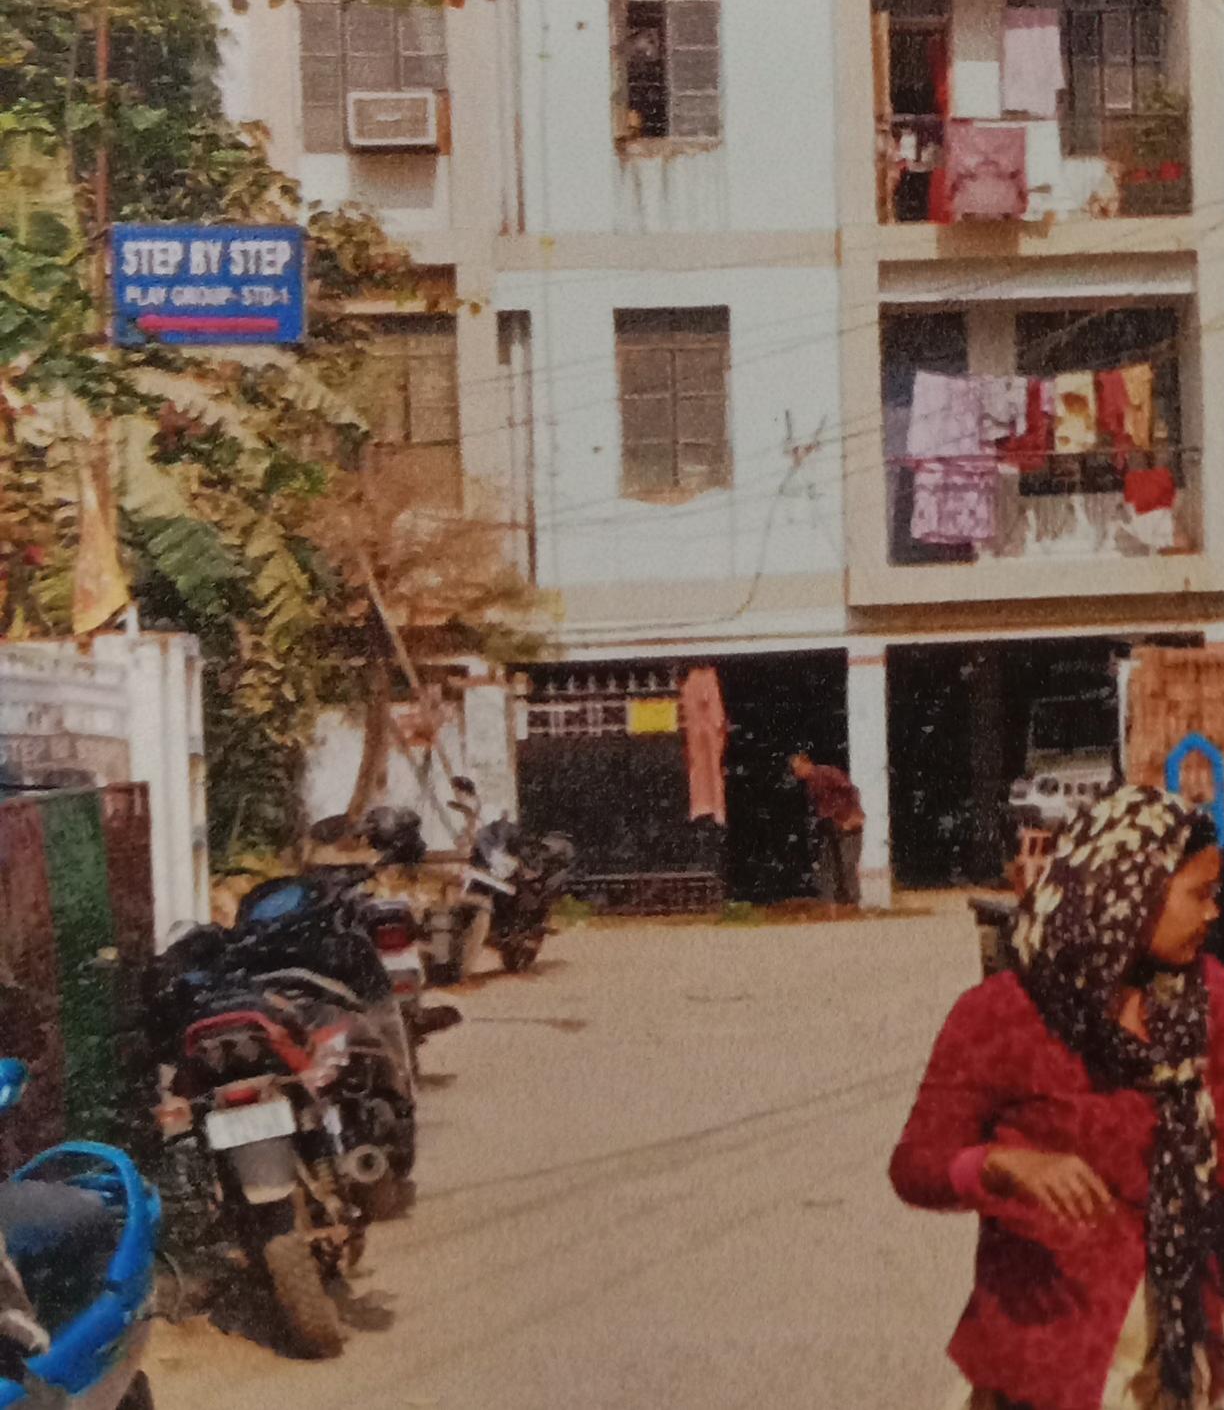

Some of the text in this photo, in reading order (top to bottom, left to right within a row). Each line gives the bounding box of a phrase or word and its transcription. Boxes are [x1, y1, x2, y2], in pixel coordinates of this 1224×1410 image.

[122, 241, 292, 276] STEP BY STEP
[125, 286, 168, 305] PLAY
